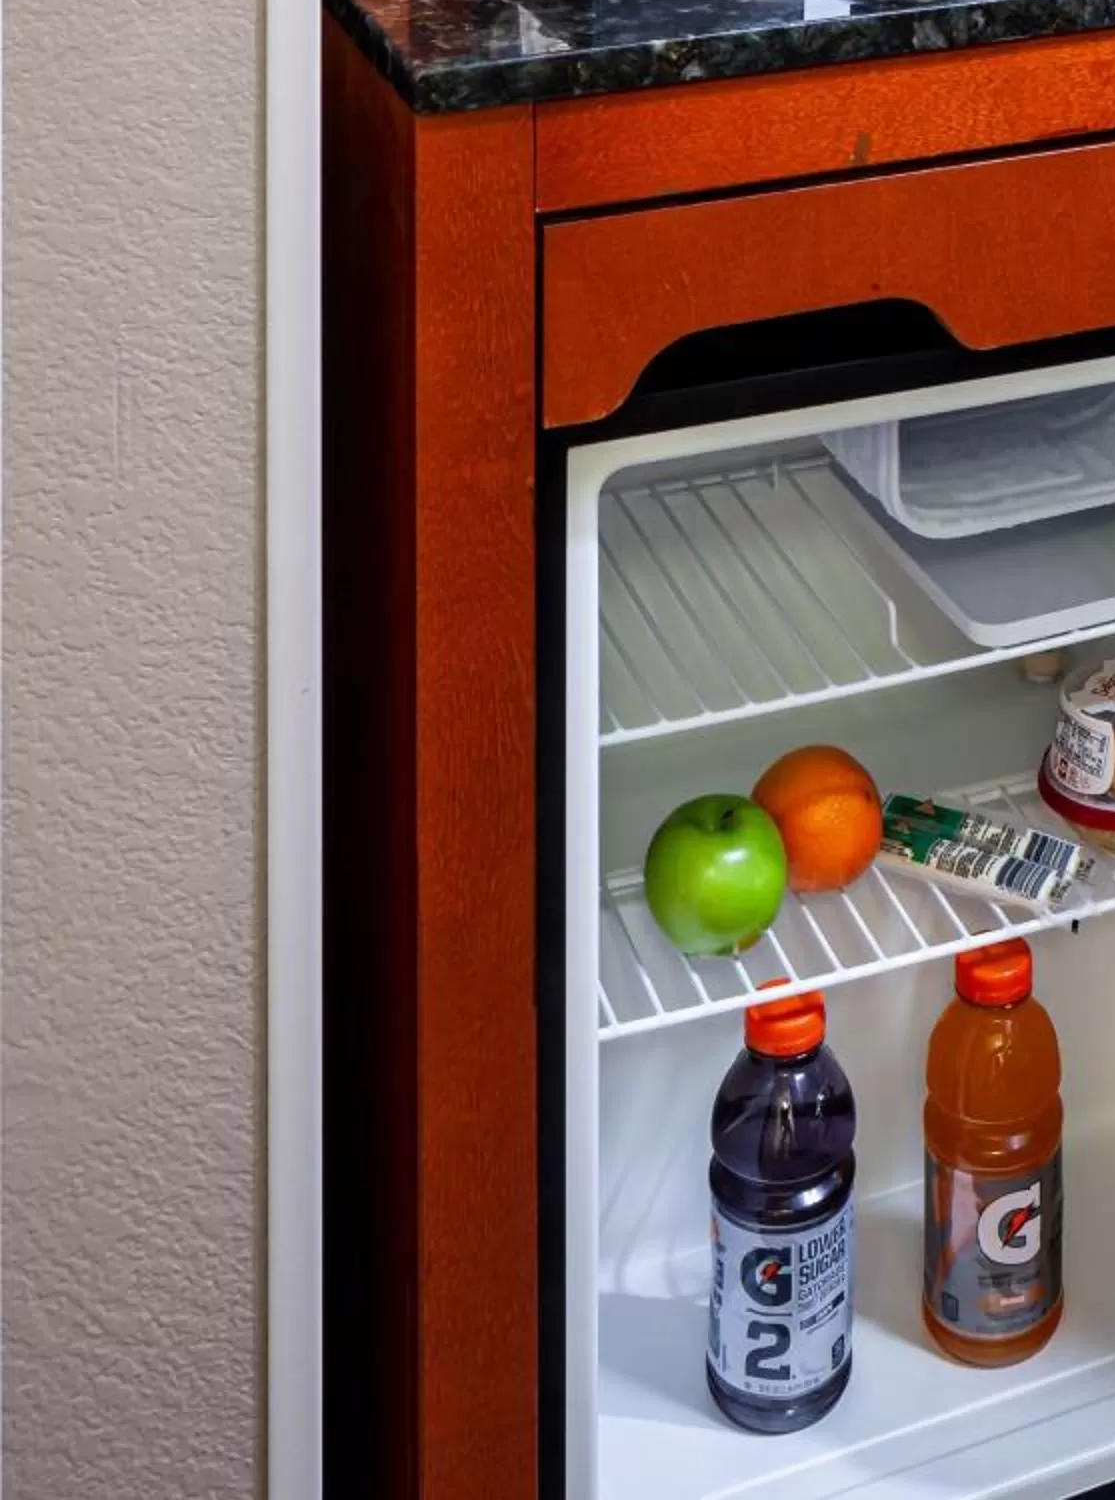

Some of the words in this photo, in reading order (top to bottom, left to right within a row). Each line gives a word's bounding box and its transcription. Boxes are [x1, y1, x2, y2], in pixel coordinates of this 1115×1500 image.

[977, 1181, 1042, 1265] G
[740, 1245, 793, 1307] G
[799, 1238, 846, 1285] SUGAR
[745, 1320, 791, 1381] 2
